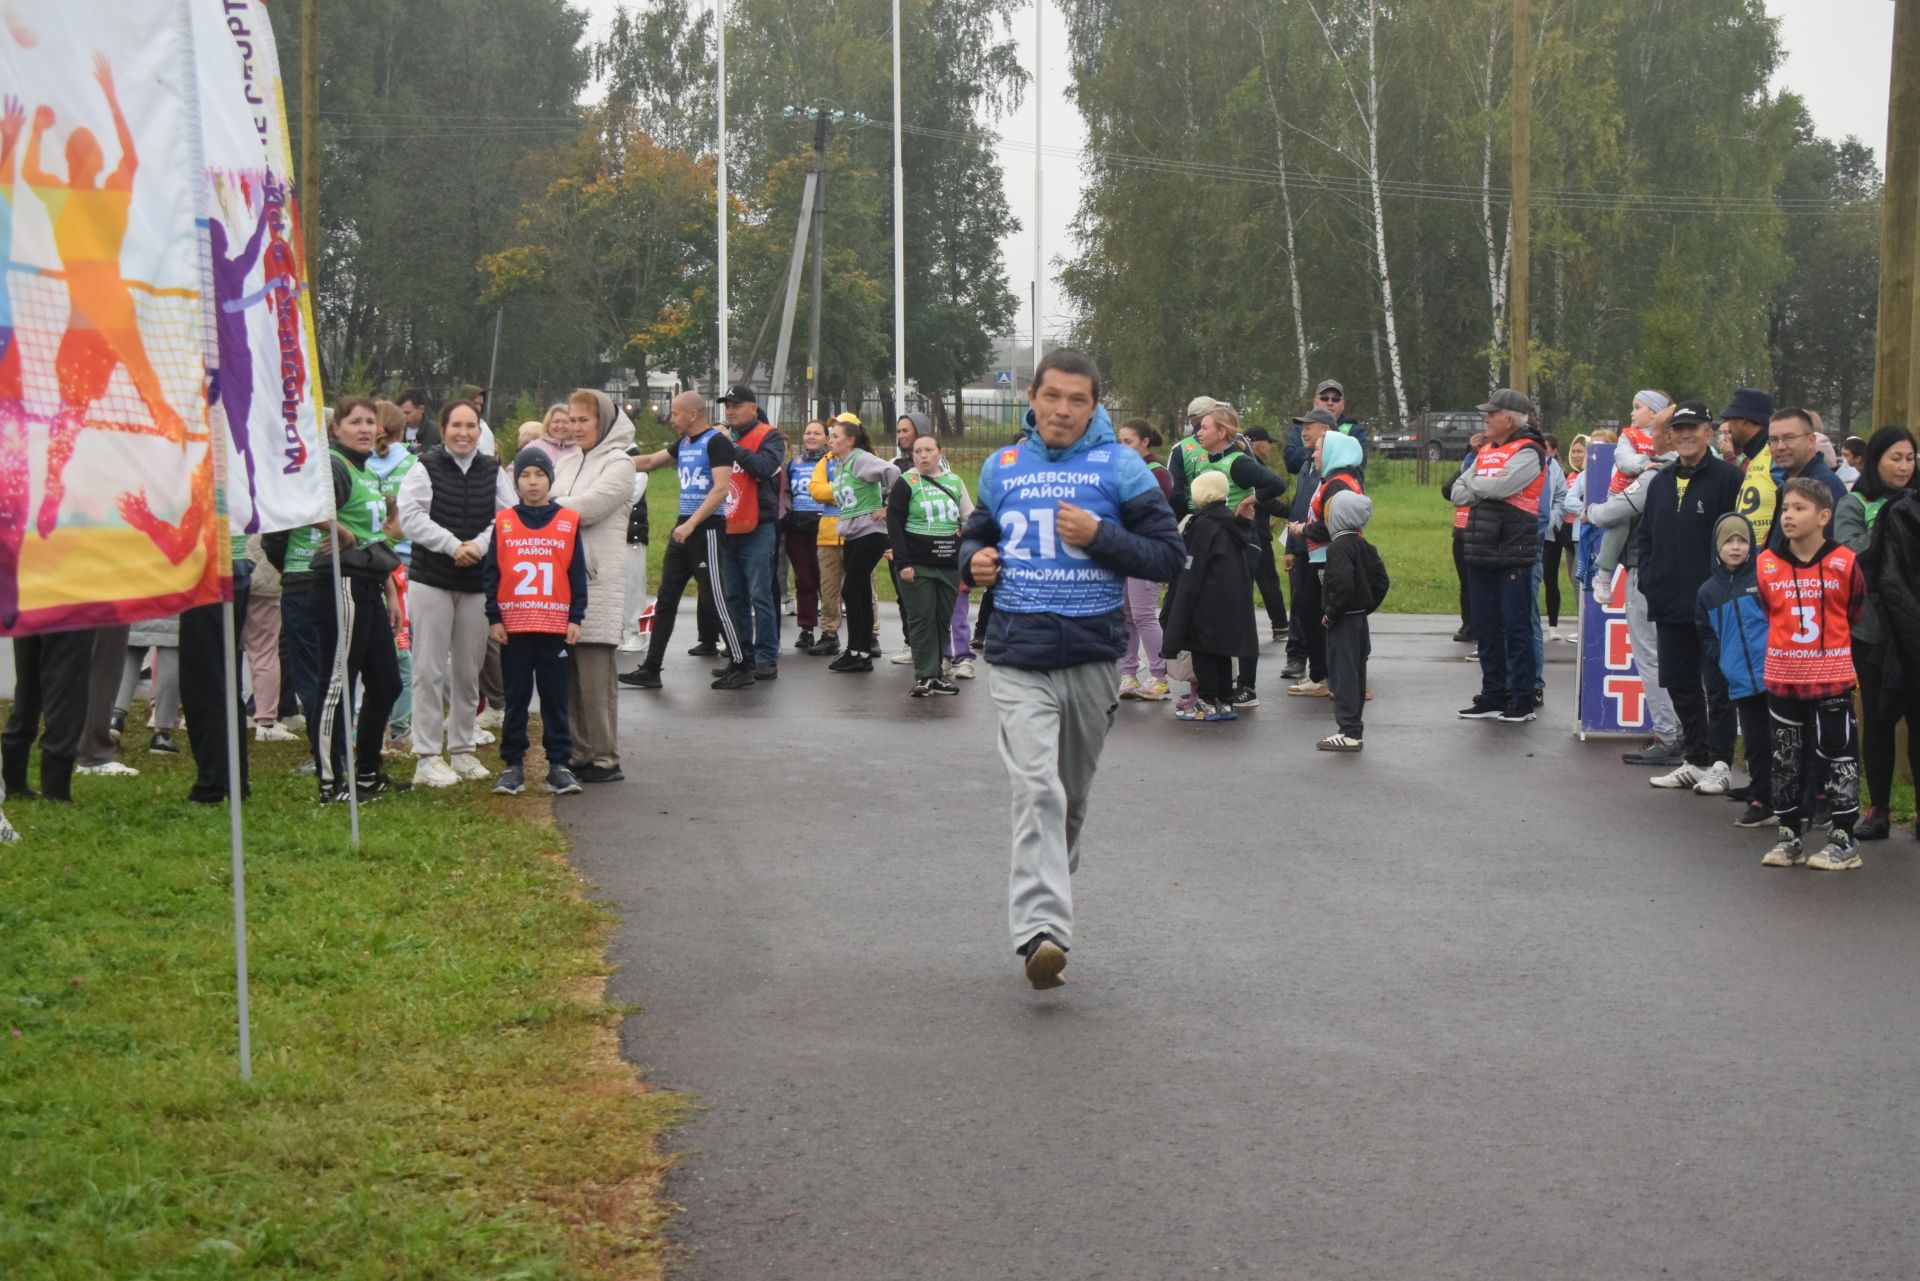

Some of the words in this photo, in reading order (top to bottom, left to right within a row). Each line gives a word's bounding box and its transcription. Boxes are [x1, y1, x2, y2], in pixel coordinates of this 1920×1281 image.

[1002, 471, 1100, 491] ТУКАЕВСКИЙ
[1020, 484, 1076, 499] РАЙОН
[920, 499, 960, 522] 118
[999, 508, 1102, 560] 21
[505, 538, 565, 550] ТУКАЕВСКИЙ
[518, 546, 552, 556] РАЙОН
[513, 561, 553, 596] 21
[1025, 569, 1075, 581] НОРМА
[1769, 578, 1839, 591] ТУКАЕВСКИЙ
[1785, 588, 1822, 599] РАЙОН
[519, 601, 548, 610] НОРМА
[1791, 605, 1820, 644] 3
